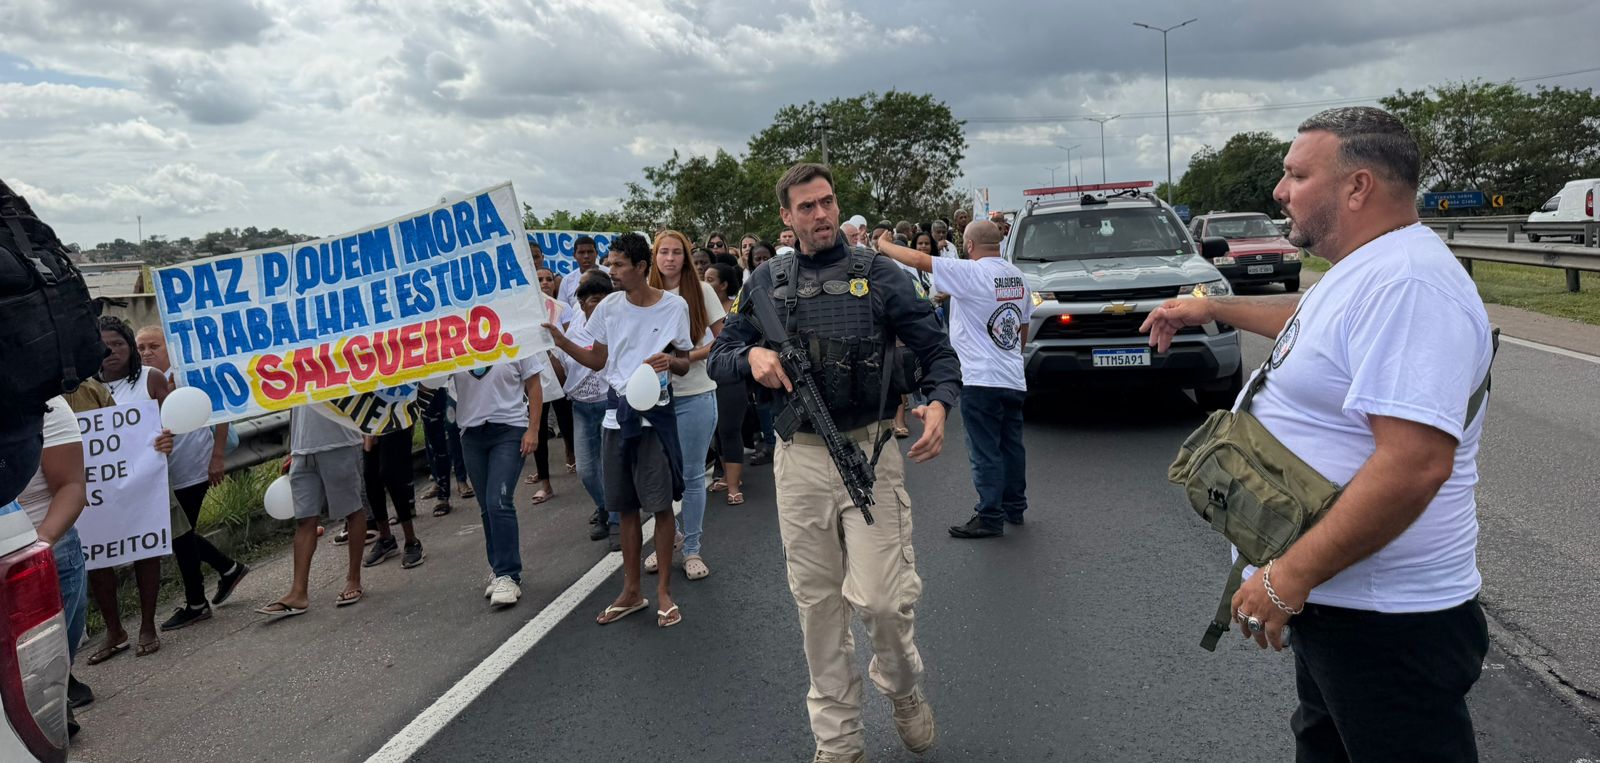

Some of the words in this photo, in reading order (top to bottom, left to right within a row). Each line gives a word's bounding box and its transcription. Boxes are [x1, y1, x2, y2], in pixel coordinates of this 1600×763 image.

[158, 257, 251, 314] PAZ
[994, 277, 1023, 288] SALGUEIRO
[169, 285, 369, 364] TRABALHA
[371, 279, 394, 325] E
[394, 243, 530, 318] ESTUDA
[186, 362, 250, 412] NO
[255, 305, 514, 400] SALGUEIRO.
[1098, 355, 1144, 365] TTM5A91
[112, 408, 141, 429] DO
[89, 434, 121, 457] DO
